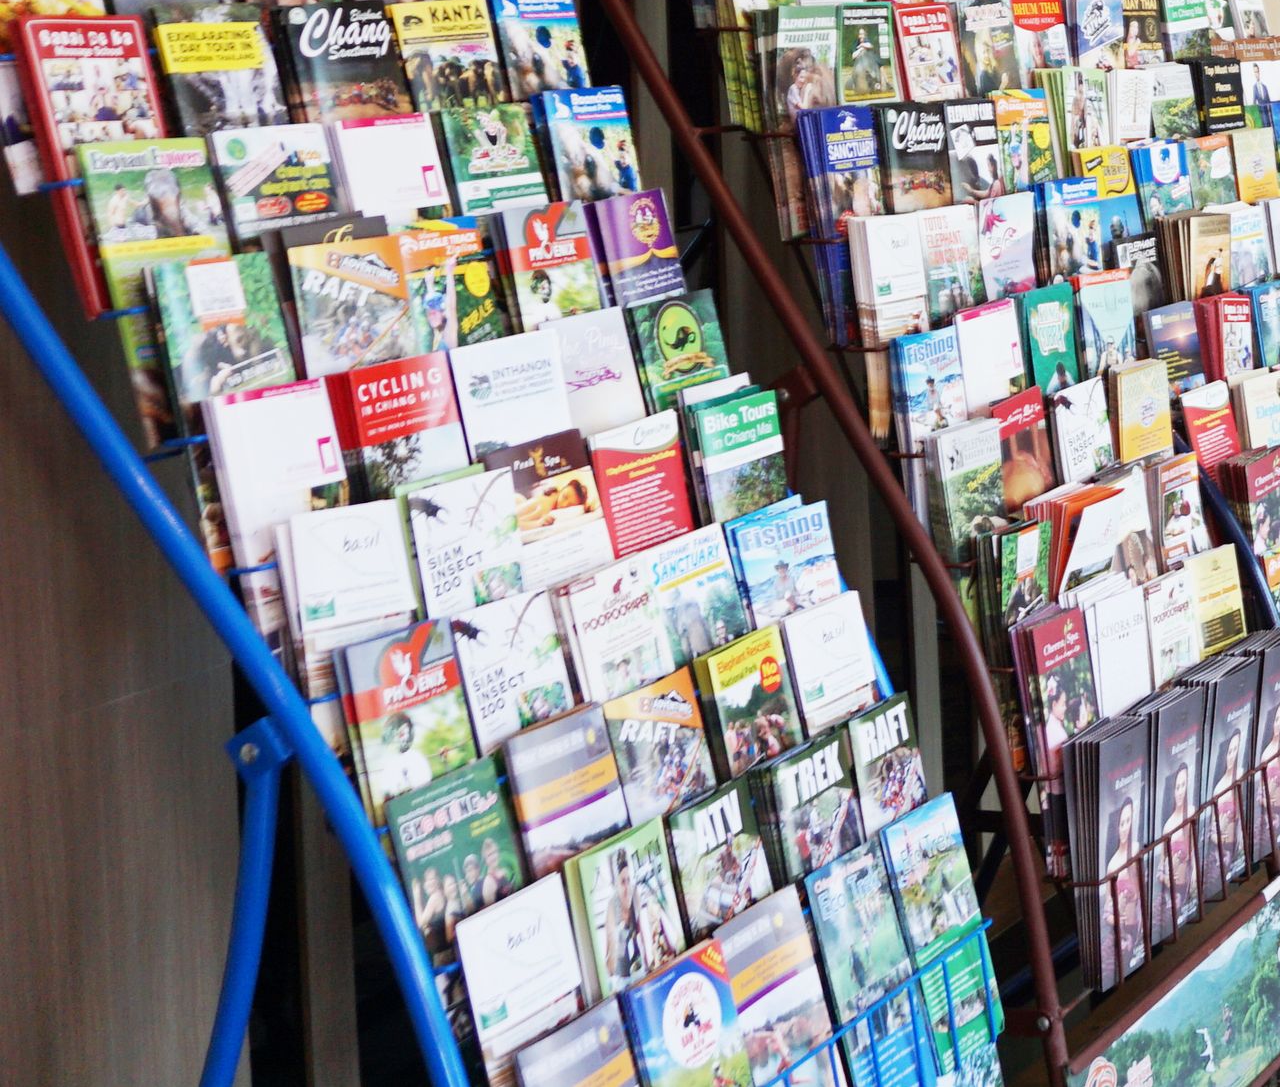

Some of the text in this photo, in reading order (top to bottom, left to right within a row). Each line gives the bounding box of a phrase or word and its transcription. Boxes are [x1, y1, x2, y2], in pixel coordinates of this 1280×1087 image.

[429, 3, 486, 24] KANTA
[300, 6, 392, 58] Chang
[893, 109, 946, 152] Chang
[828, 137, 877, 161] SANCTUARY
[302, 271, 376, 307] RAFT
[906, 334, 954, 363] Fishing
[357, 367, 442, 403] CYCLING
[375, 393, 416, 414] CHIANG
[703, 399, 776, 435] Bike Tours
[343, 530, 380, 553] basil
[738, 510, 824, 553] Fishing
[428, 544, 463, 570] SIAM
[431, 550, 485, 583] INSECT
[434, 576, 462, 598] ZOO
[472, 666, 504, 693] SIAM
[476, 671, 526, 707] INSECT
[481, 696, 505, 720] ZOO
[619, 718, 681, 744] RAFT
[783, 740, 844, 810] TREK
